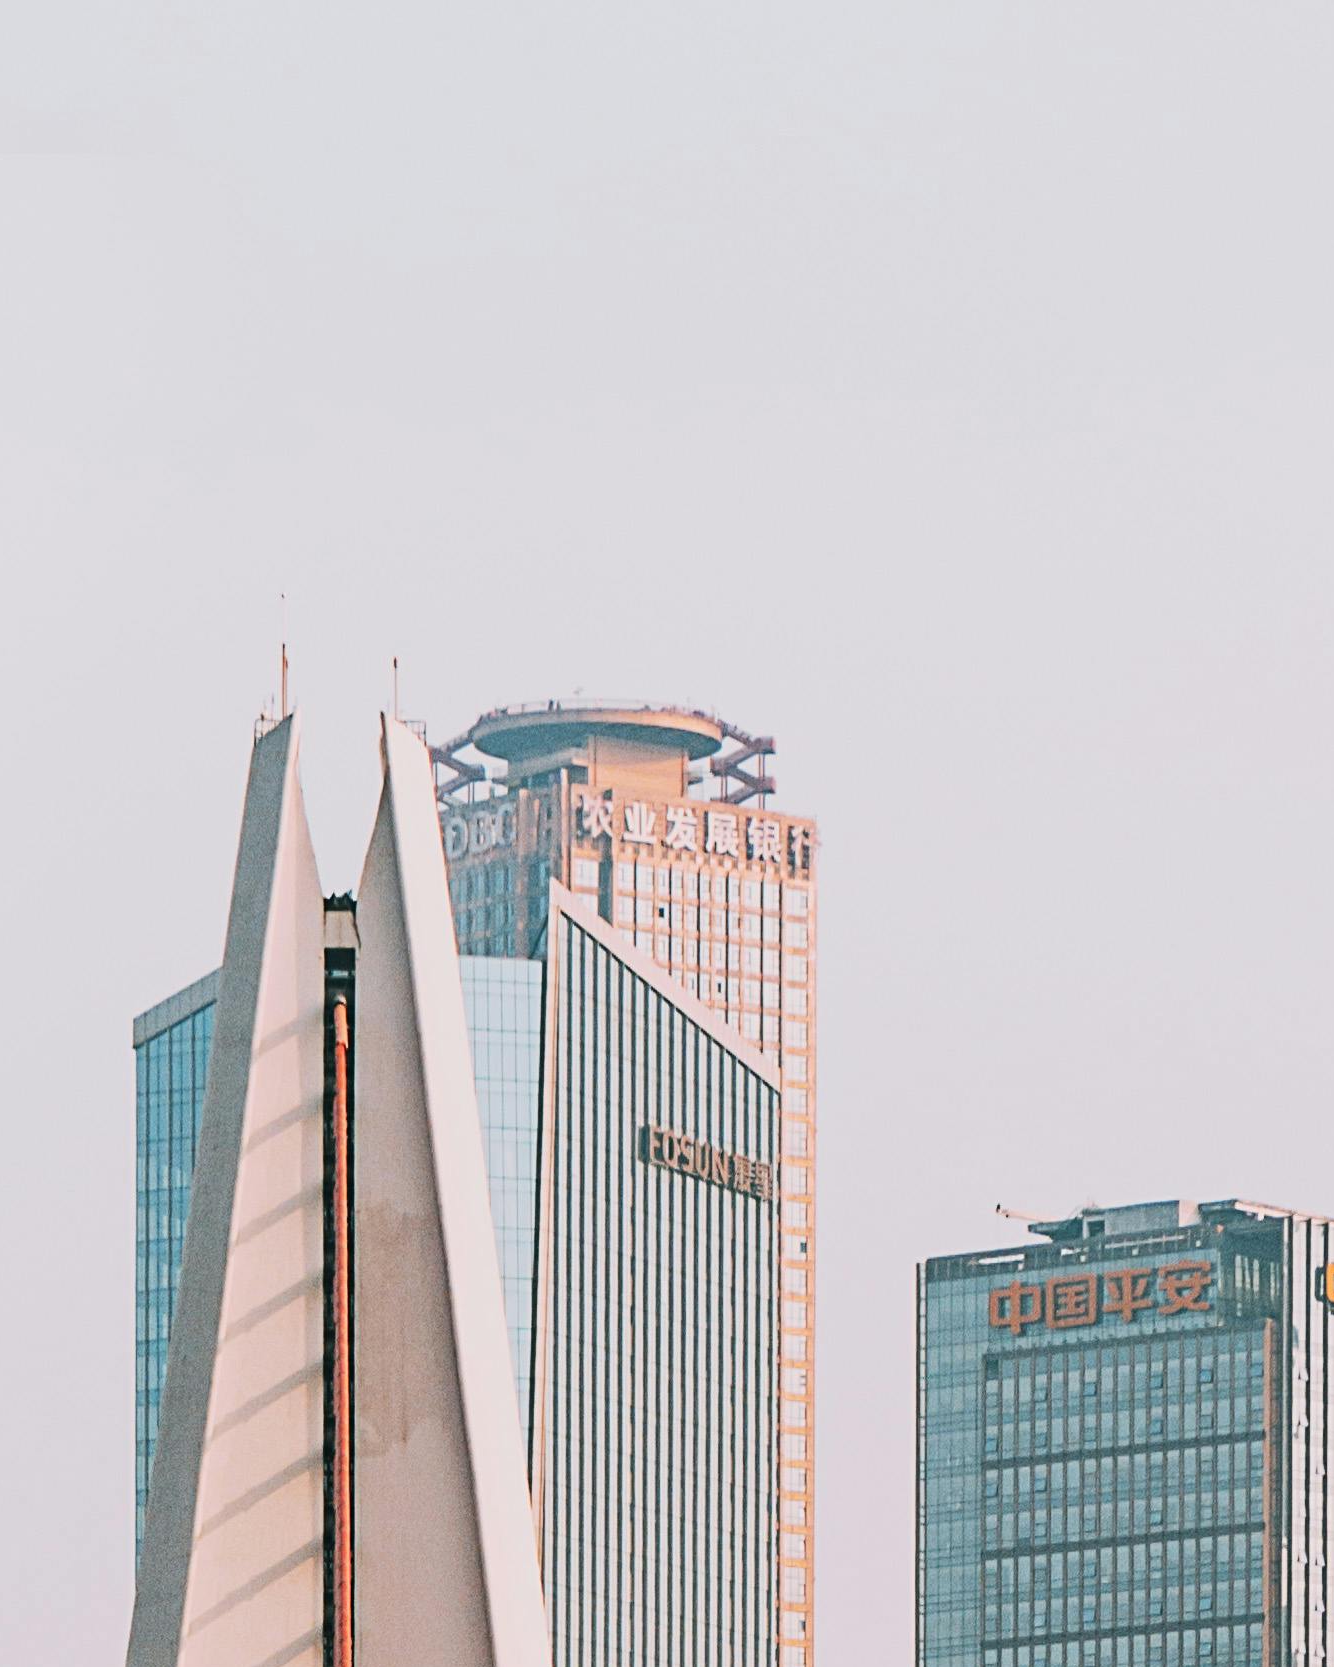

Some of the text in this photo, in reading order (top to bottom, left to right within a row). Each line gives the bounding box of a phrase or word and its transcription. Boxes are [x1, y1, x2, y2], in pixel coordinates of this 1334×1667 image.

[650, 1125, 729, 1186] FOSUN
[989, 1259, 1213, 1336] 中国平安
